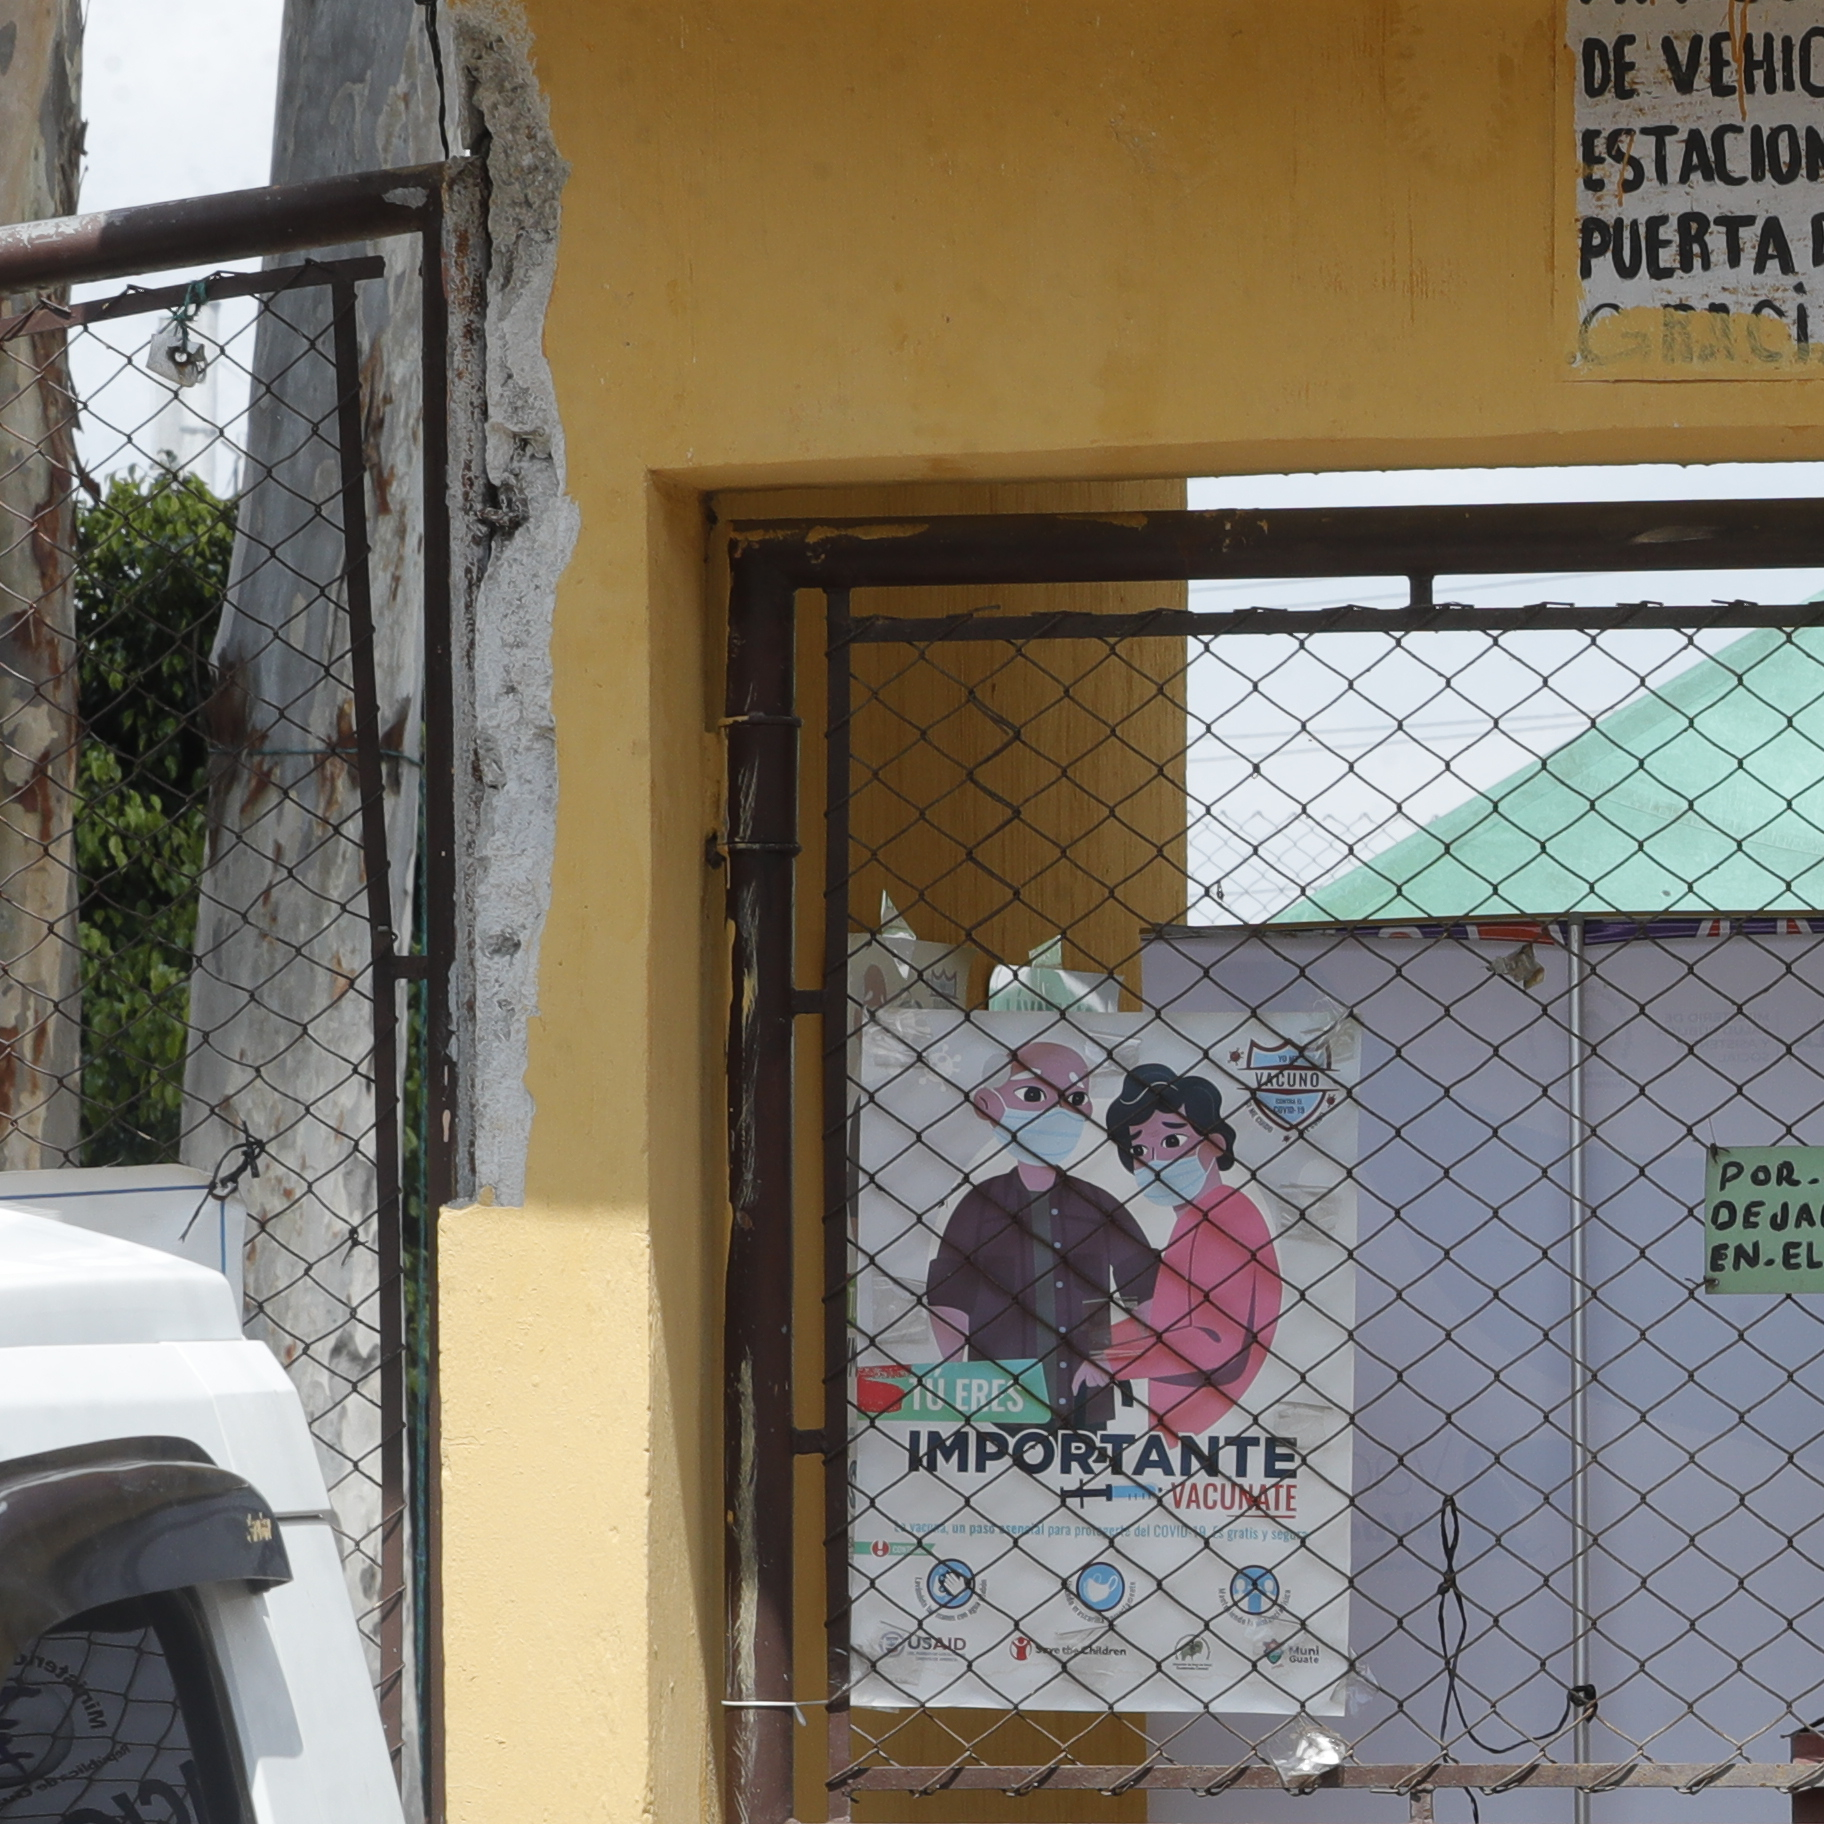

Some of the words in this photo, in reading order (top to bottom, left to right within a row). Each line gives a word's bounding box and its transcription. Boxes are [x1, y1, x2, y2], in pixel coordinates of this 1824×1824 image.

[1582, 34, 1636, 100] DE
[1580, 211, 1795, 281] PUERTA
[1255, 1072, 1319, 1087] VACUNO
[908, 1369, 943, 1410] TÚ
[956, 1378, 1024, 1412] ERES
[908, 1429, 1297, 1478] IMPORTANTE
[908, 1637, 966, 1650] USAID
[1289, 1645, 1319, 1656] Muni
